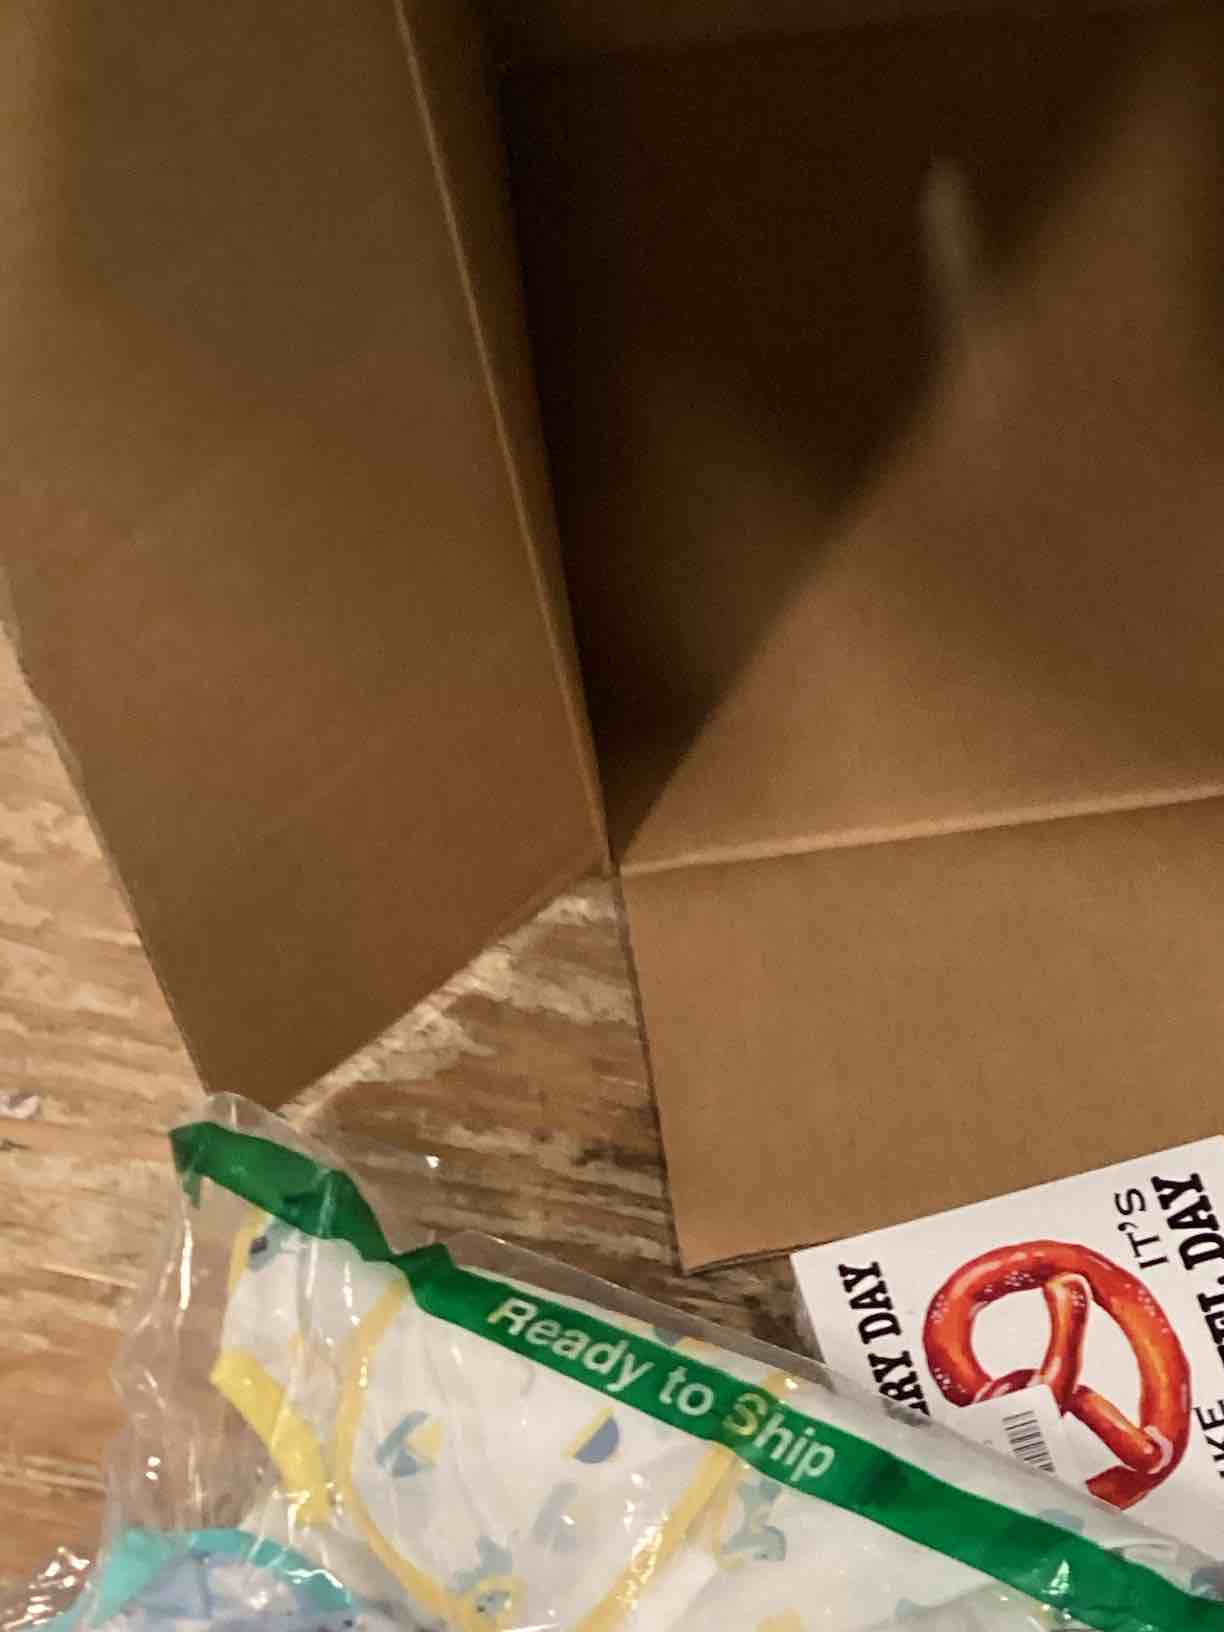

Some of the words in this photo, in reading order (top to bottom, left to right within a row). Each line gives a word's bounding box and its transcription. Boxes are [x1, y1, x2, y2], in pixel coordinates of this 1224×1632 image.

[1108, 1184, 1169, 1271] IT'S
[836, 1260, 902, 1345] DAY
[487, 1298, 654, 1391] Ready
[659, 1365, 716, 1418] to
[720, 1392, 838, 1480] Ship
